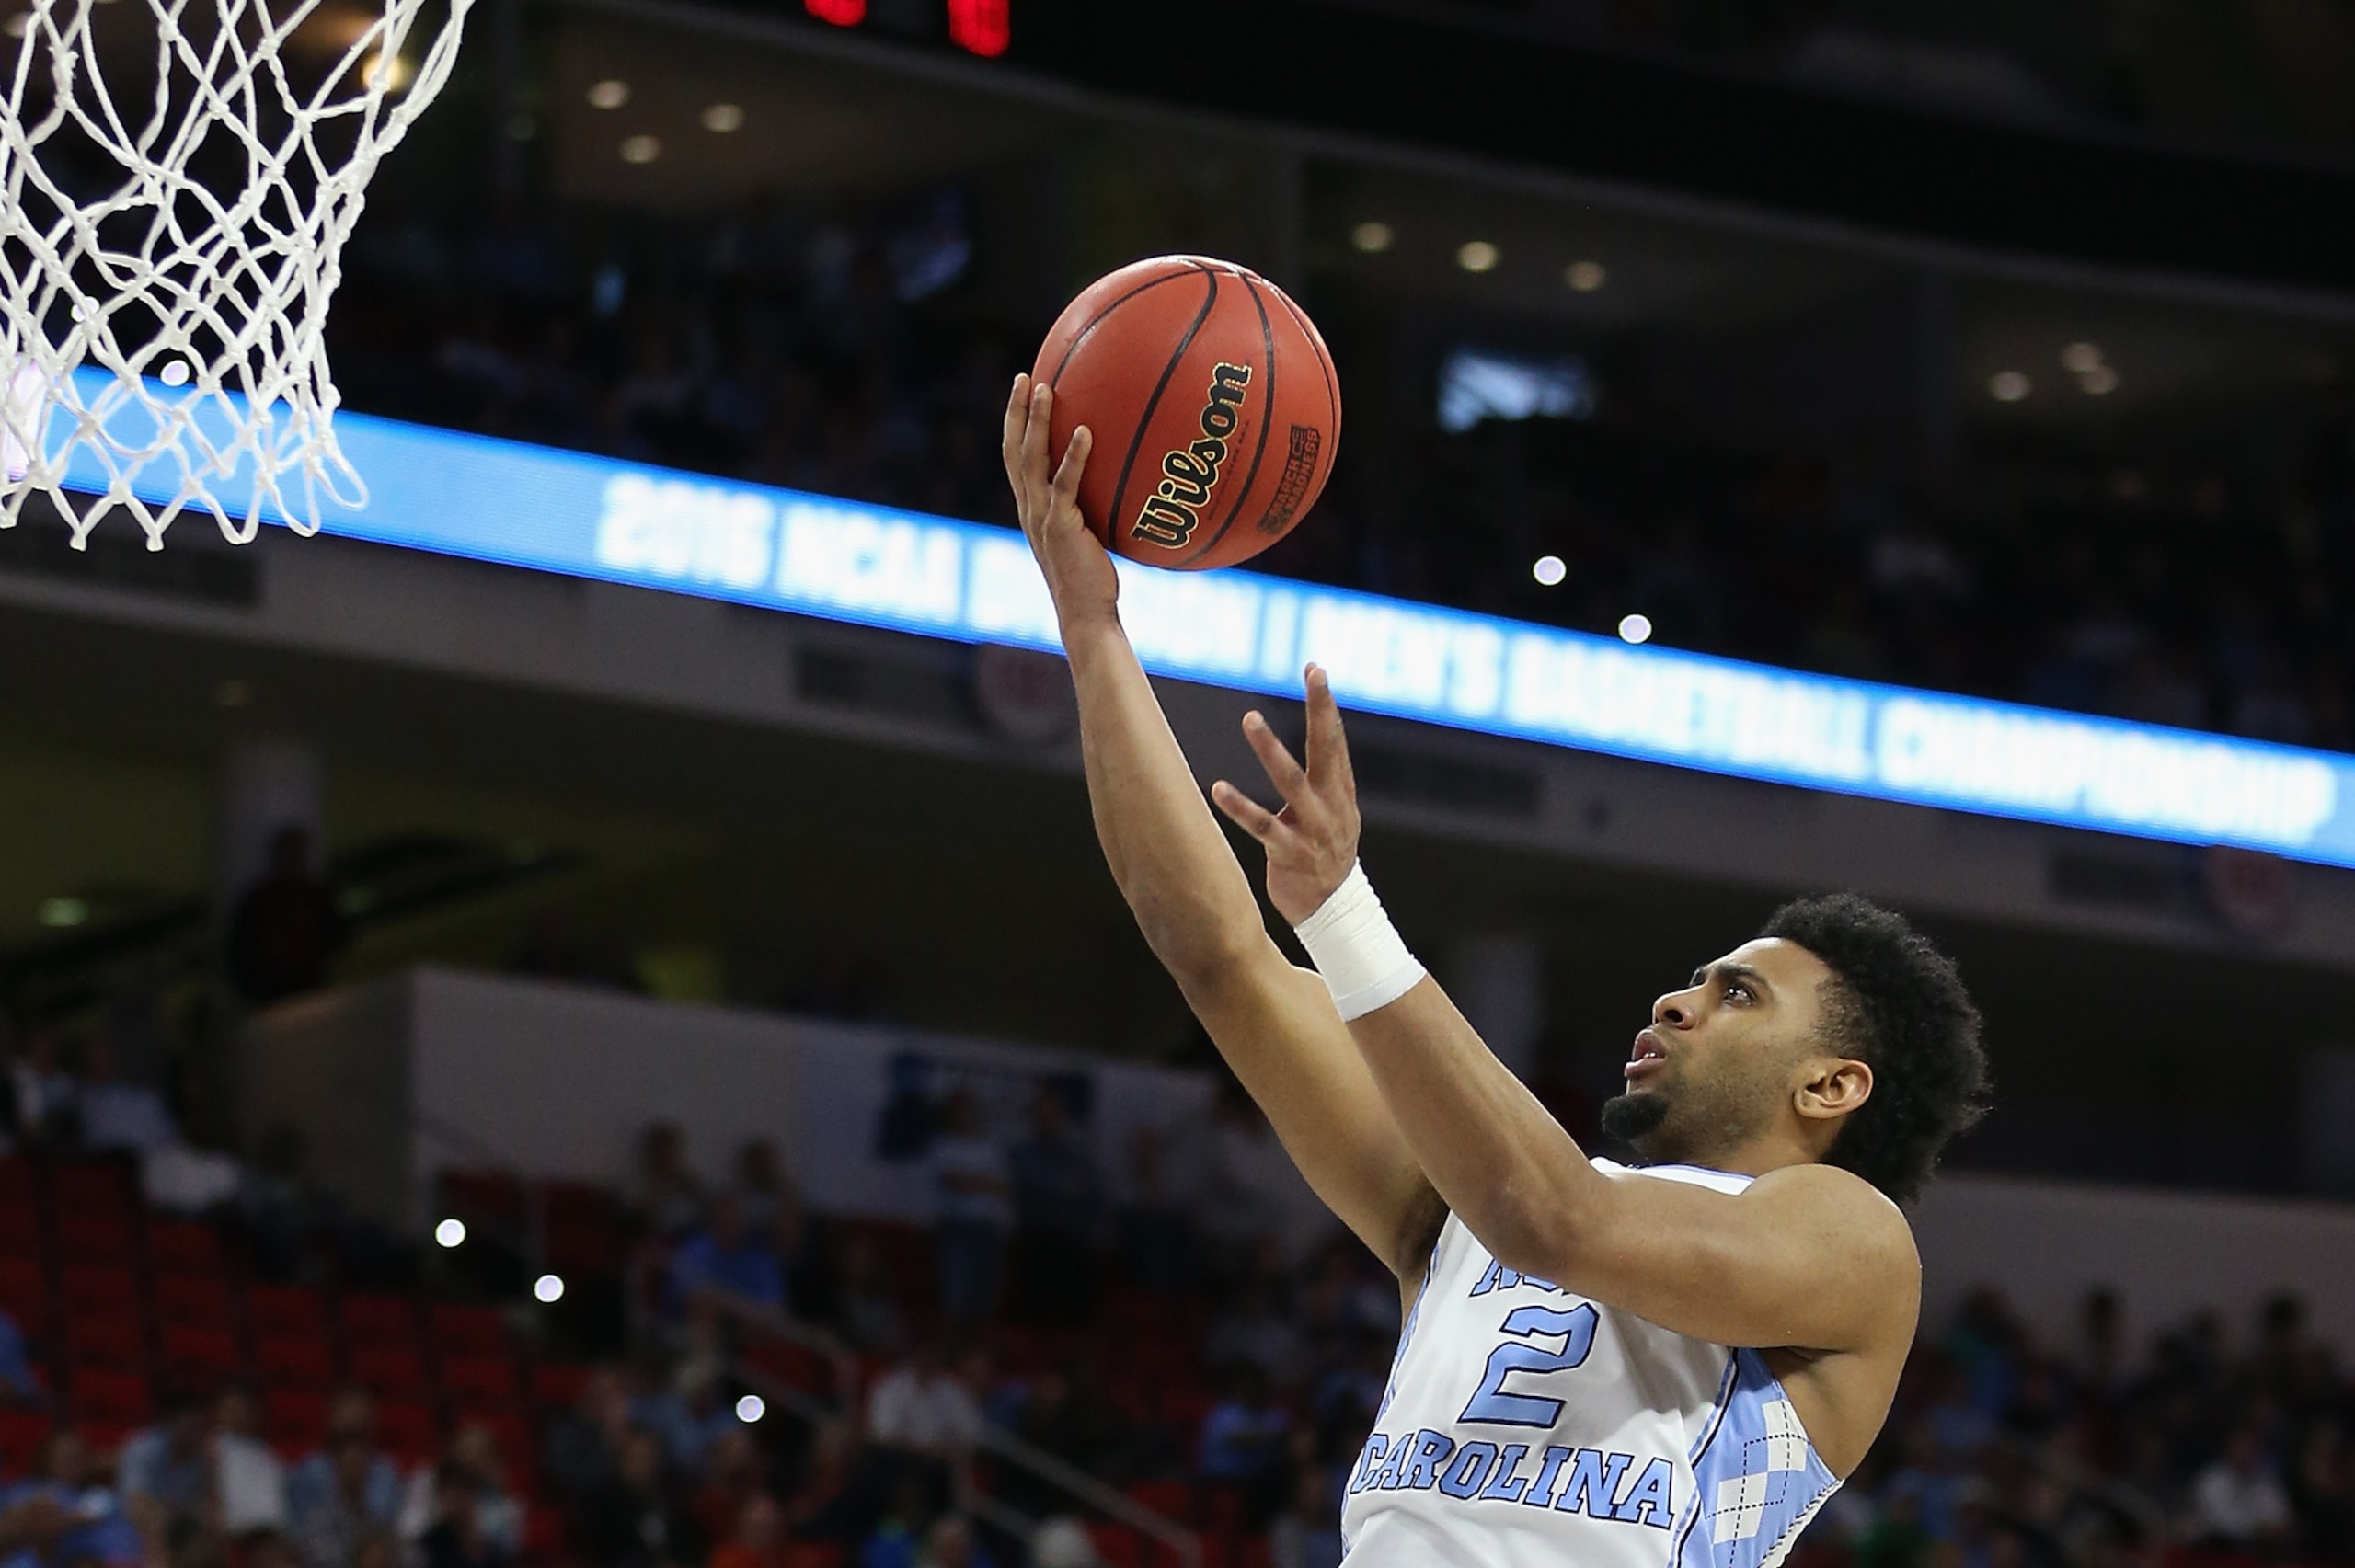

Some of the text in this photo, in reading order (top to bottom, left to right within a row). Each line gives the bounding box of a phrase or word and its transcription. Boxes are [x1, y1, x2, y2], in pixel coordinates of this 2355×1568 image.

[1130, 361, 1253, 550] Wilson
[1267, 457, 1300, 515] MARCH
[1283, 427, 1320, 509] MADNESS
[595, 472, 775, 592] 2016
[775, 500, 963, 625] NCAA
[1503, 631, 1868, 784] BASKETBALL
[1877, 695, 2338, 845] CHAMPIONSHIP
[1456, 1301, 1601, 1429] 2
[1350, 1428, 1675, 1530] CAROLINA
